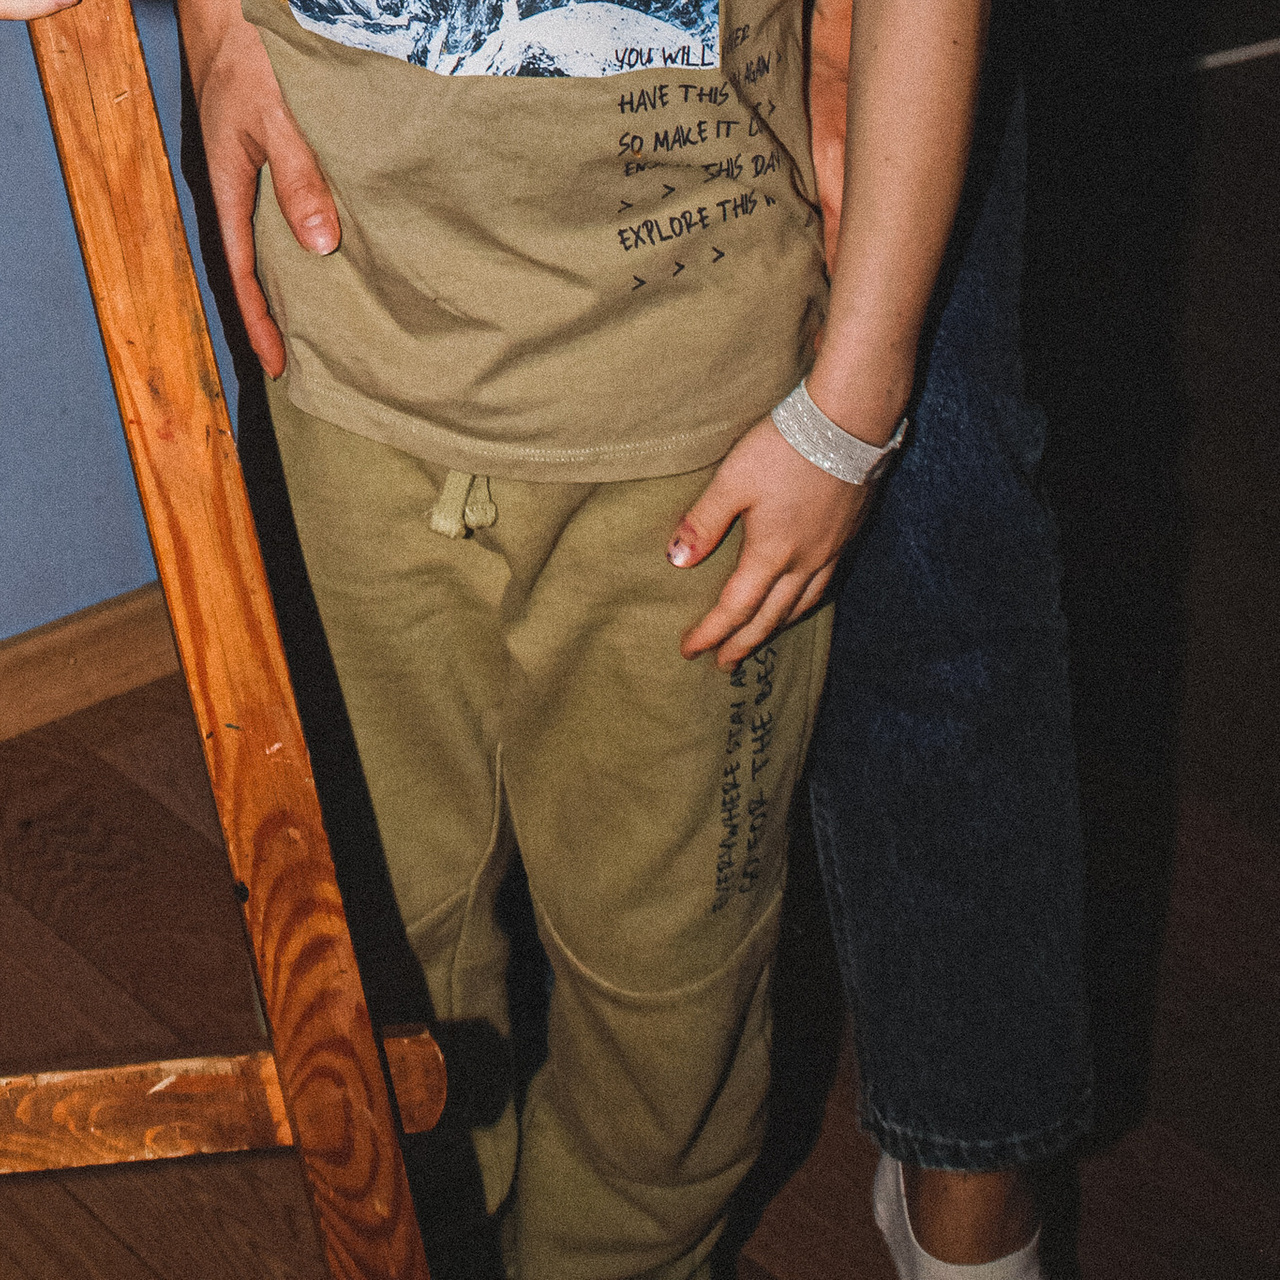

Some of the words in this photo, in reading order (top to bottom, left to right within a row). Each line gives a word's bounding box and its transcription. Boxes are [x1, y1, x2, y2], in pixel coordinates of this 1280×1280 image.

[615, 46, 653, 71] YOU
[661, 44, 715, 67] WILL
[617, 84, 670, 114] HAVE
[678, 81, 730, 106] THIS
[617, 131, 645, 157] SO
[653, 120, 709, 153] MAKE
[716, 120, 740, 140] IT
[617, 206, 710, 252] EXPLORE
[716, 191, 758, 223] THIS
[751, 711, 773, 782] THE
